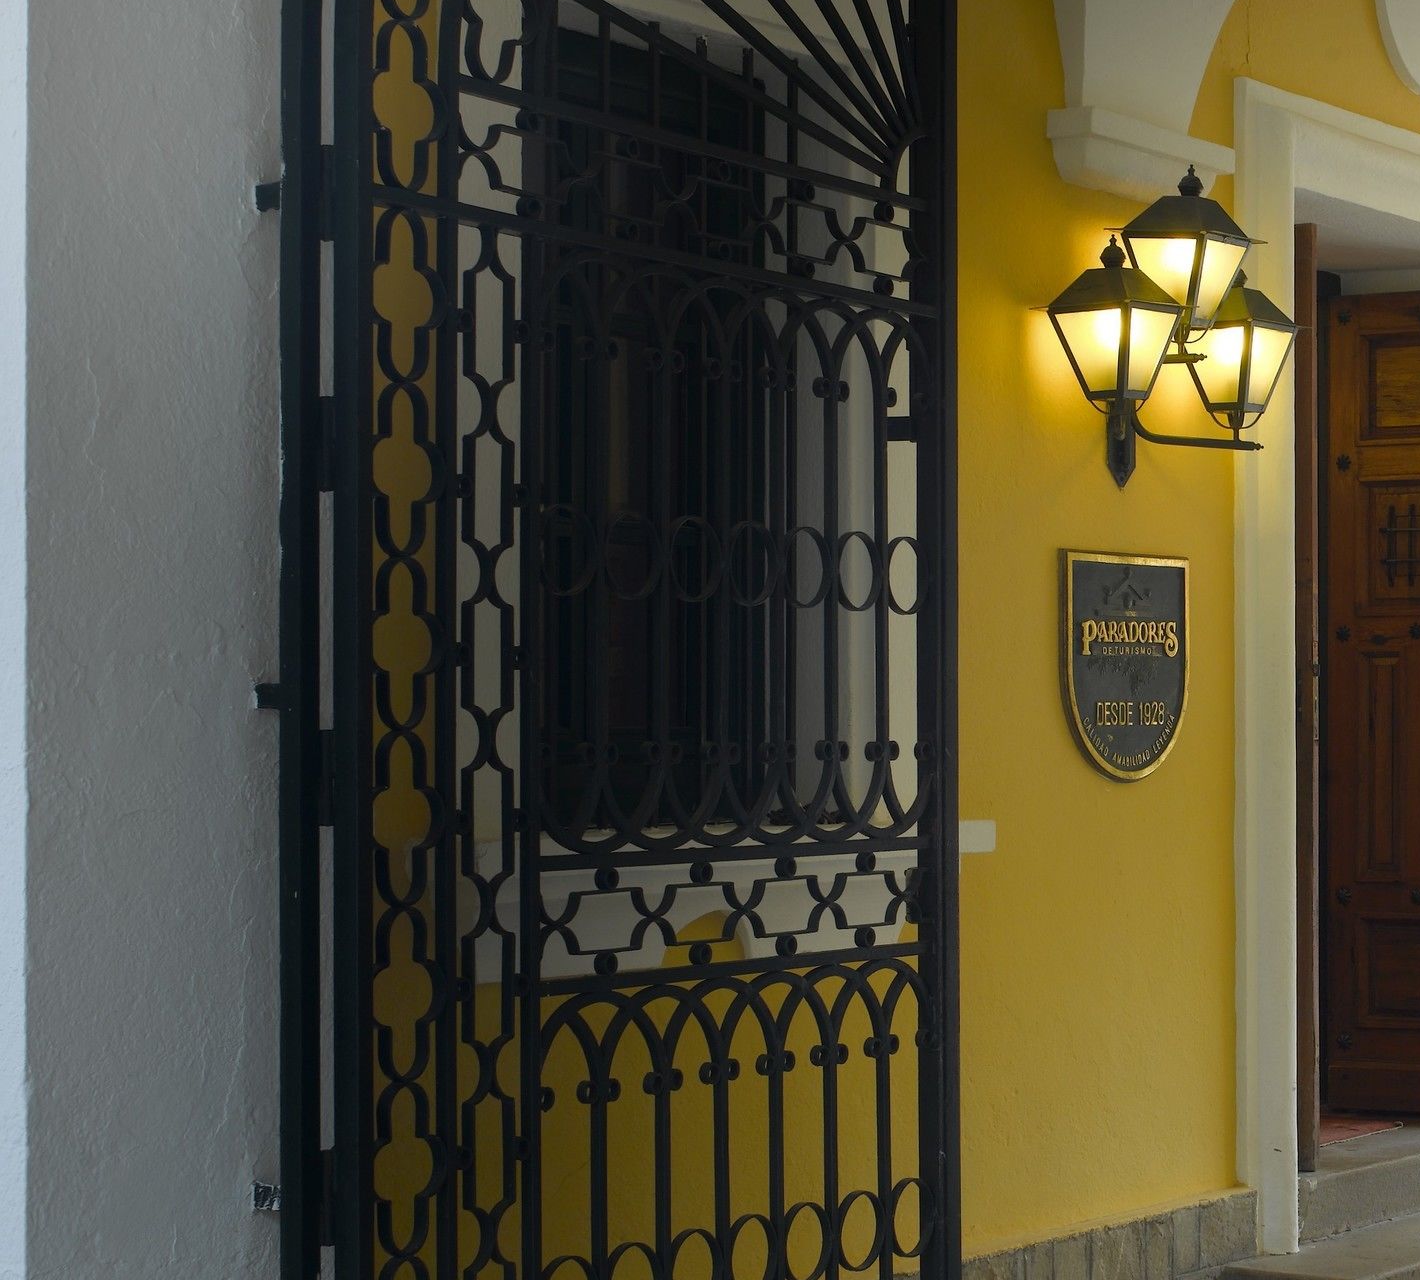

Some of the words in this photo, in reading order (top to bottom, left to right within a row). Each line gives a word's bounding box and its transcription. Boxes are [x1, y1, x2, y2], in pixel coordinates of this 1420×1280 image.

[1082, 619, 1179, 658] PARADORES
[1102, 646, 1112, 655] DE
[1115, 646, 1152, 656] TURISMO
[1097, 701, 1133, 726] DESDE
[1139, 701, 1165, 726] 1928
[1083, 717, 1109, 757] CALIDAD
[1112, 749, 1151, 767] AMABILIDAD
[1152, 714, 1175, 754] LEYENDA
